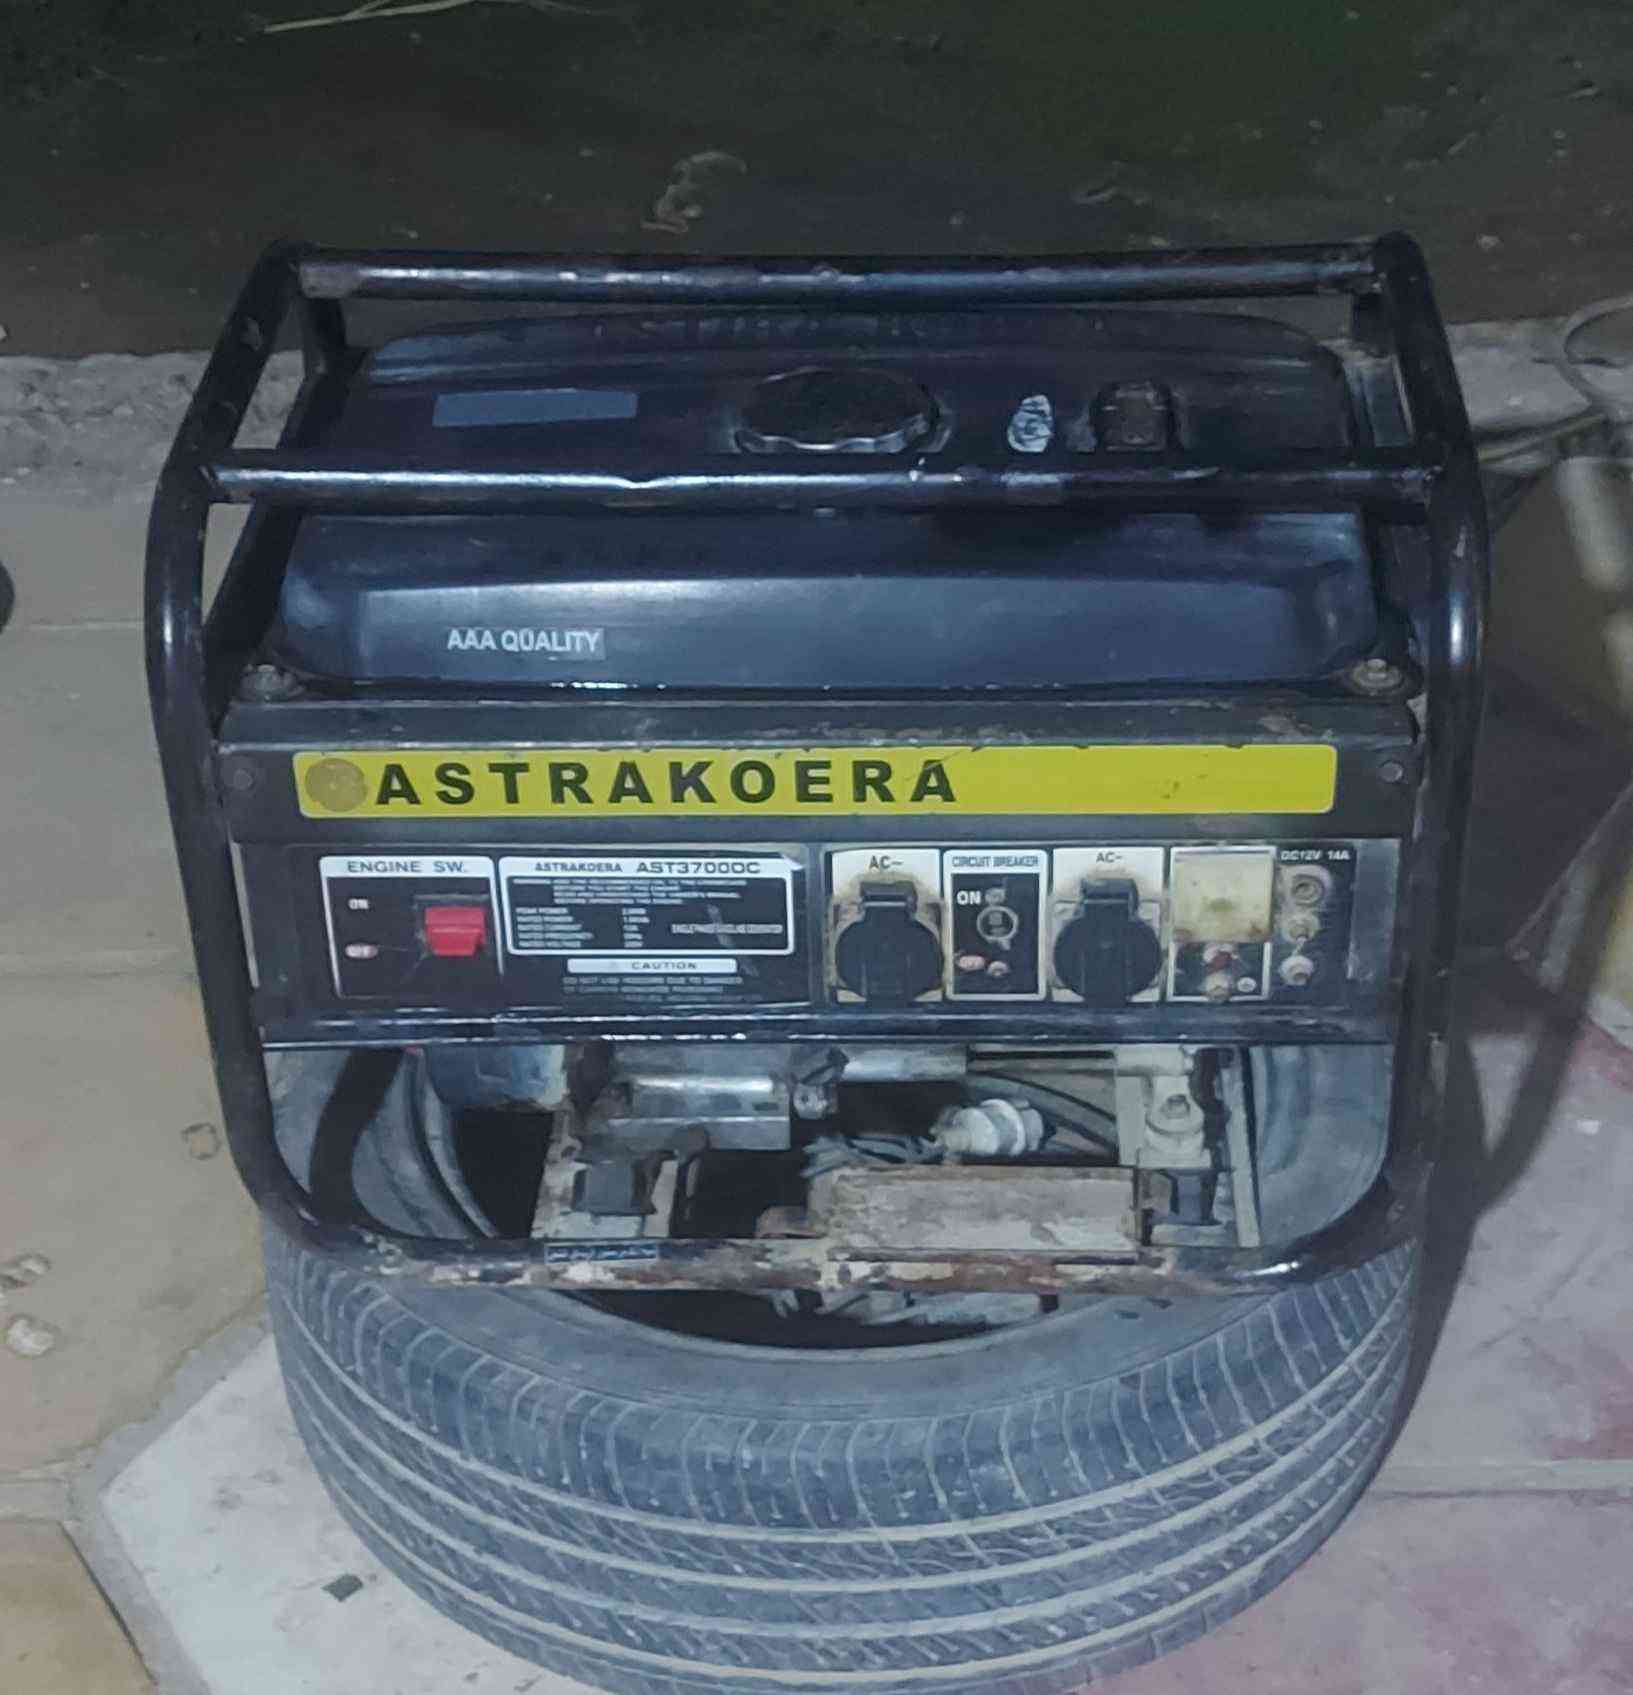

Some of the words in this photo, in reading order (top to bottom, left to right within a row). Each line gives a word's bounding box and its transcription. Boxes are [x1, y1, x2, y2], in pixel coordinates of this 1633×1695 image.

[447, 628, 497, 650] AAA
[501, 628, 601, 651] QUALITY
[376, 758, 957, 806] ASTRAKOERA
[952, 855, 991, 867] CIRCUIT
[992, 855, 1039, 867] BREAKER
[1327, 850, 1351, 861] 14A
[346, 860, 422, 873] ENGINE
[956, 889, 982, 905] ON
[630, 961, 698, 970] CAUTION
